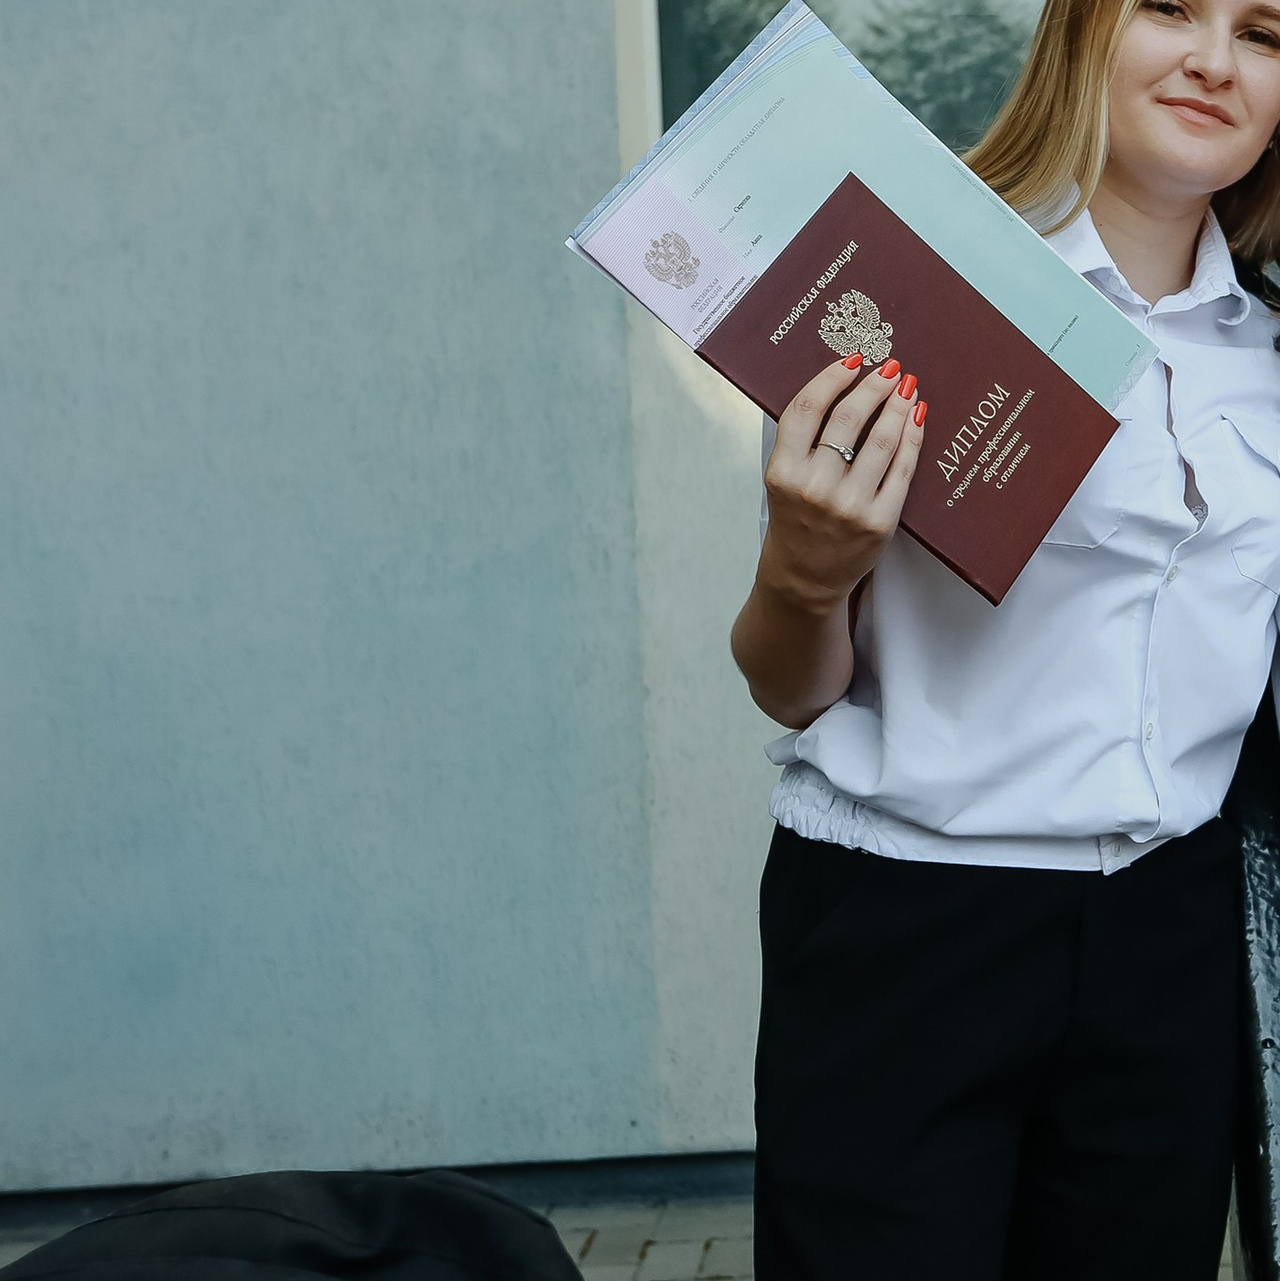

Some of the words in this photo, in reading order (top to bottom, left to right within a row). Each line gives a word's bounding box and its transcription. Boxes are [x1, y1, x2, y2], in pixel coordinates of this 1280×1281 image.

[769, 286, 821, 346] РОССИЙСКАЯ
[815, 239, 860, 290] ФЕДЕРАЦИЯ
[936, 381, 1012, 483] ДИПЛОМ
[945, 498, 955, 508] о
[951, 461, 982, 501] среднем
[976, 387, 1037, 466] профессиональном
[981, 429, 1024, 484] образовании
[994, 481, 1004, 490] с
[999, 442, 1032, 483] отличием
